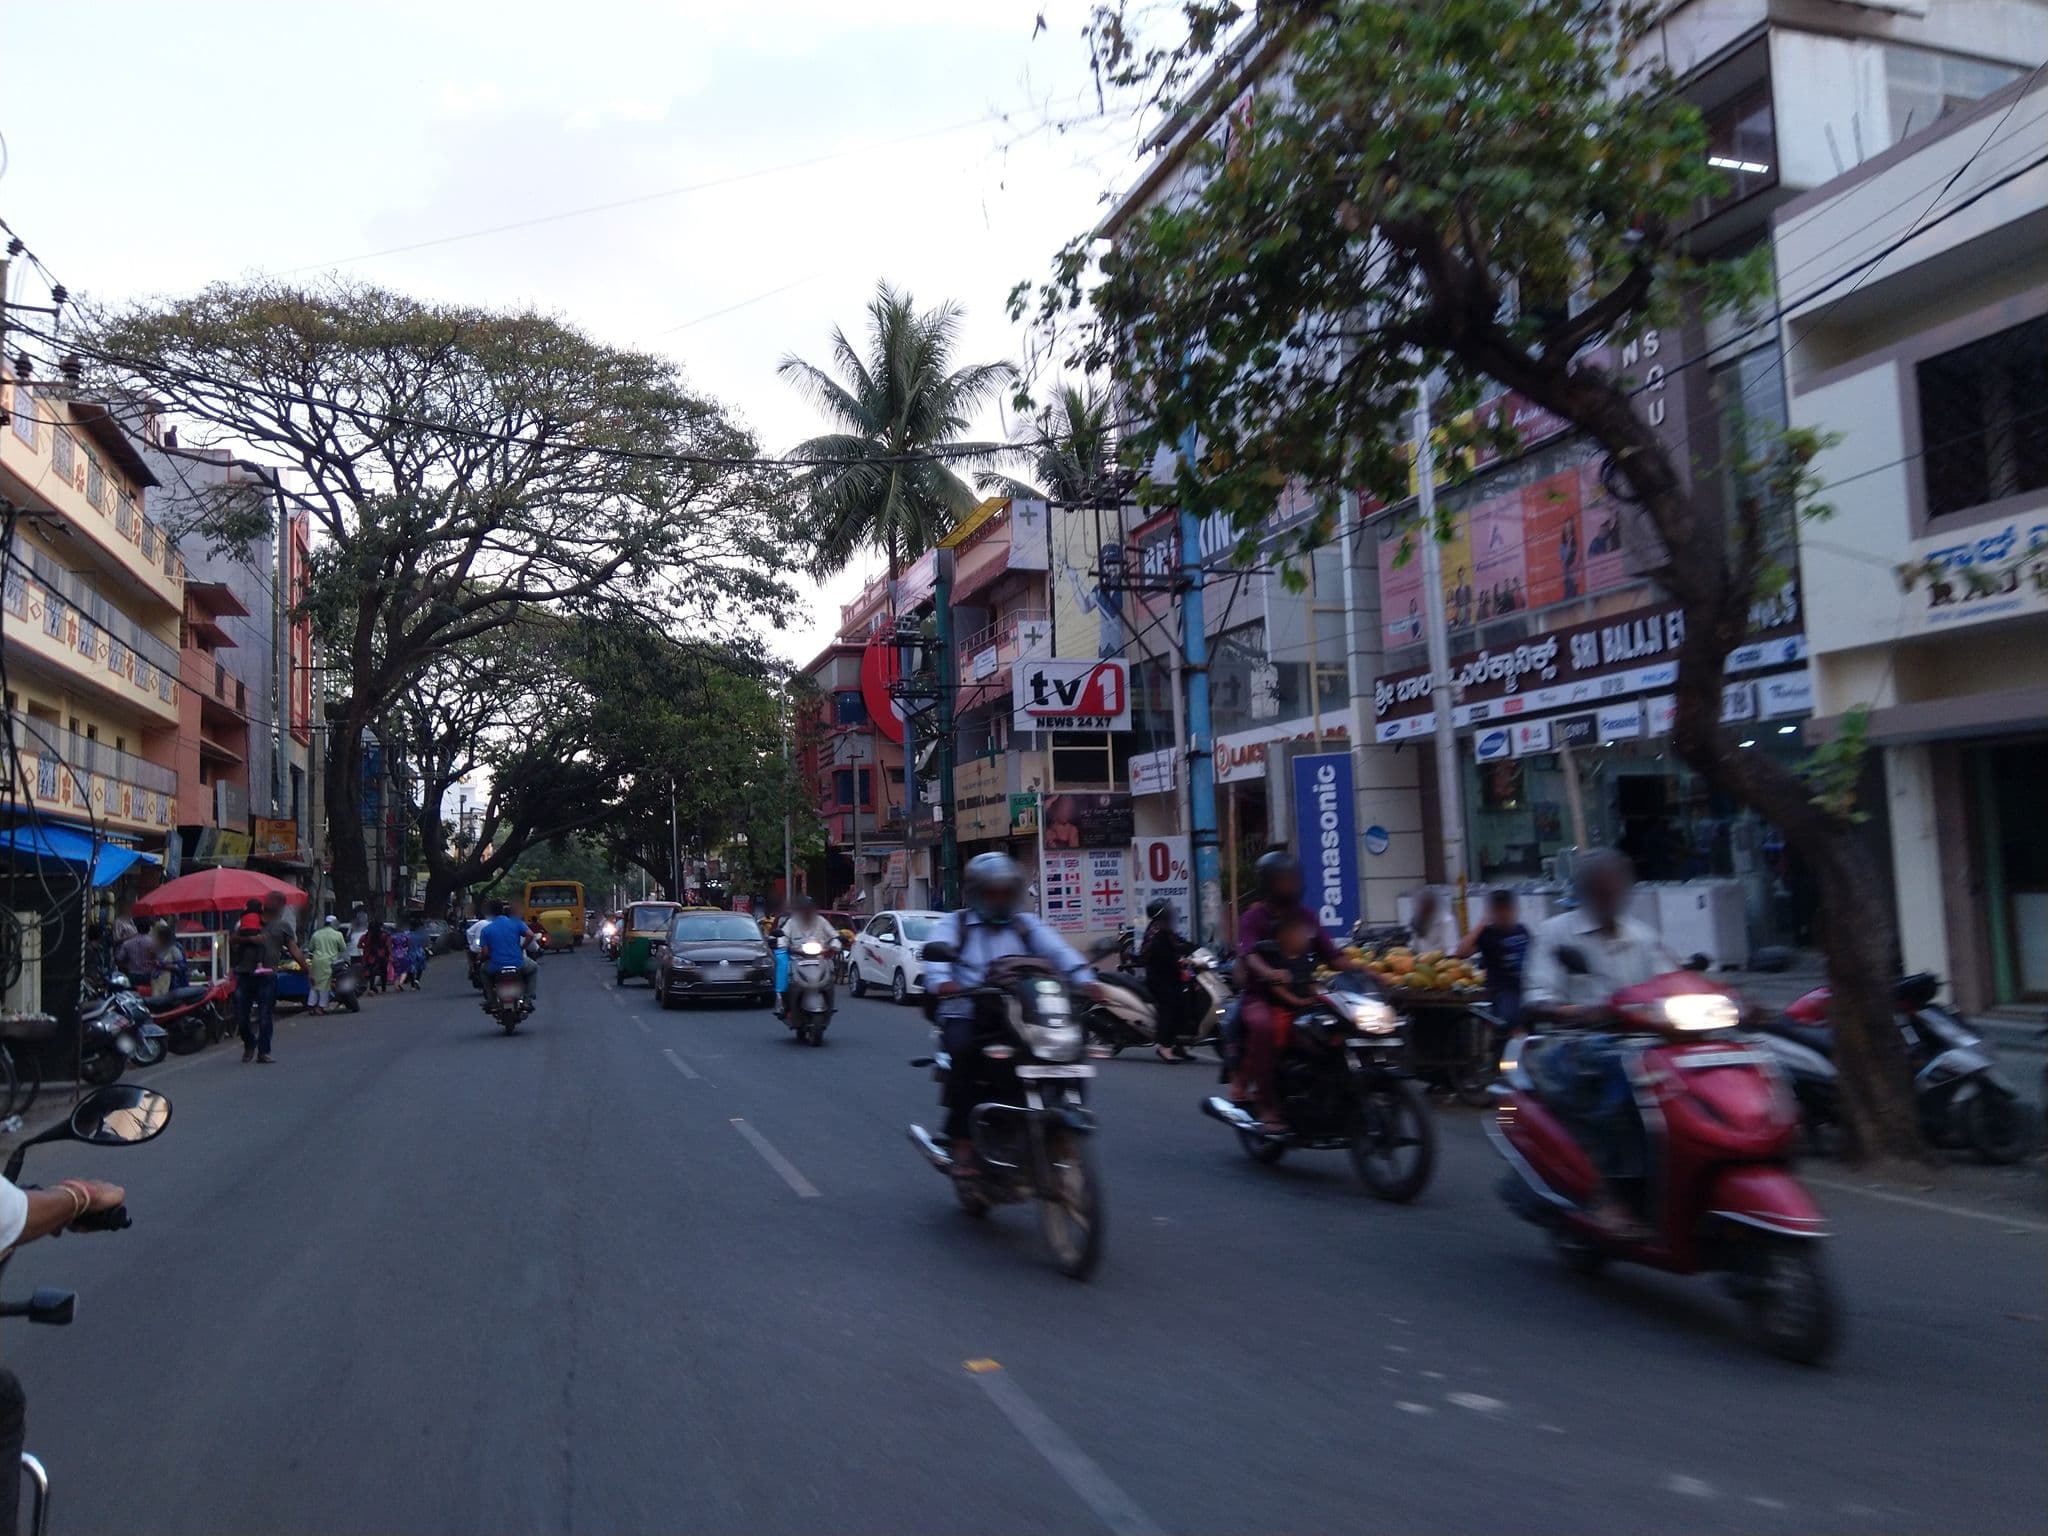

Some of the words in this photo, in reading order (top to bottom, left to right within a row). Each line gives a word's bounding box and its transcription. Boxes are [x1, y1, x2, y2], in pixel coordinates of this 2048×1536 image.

[1570, 630, 1600, 671] SRI
[1036, 716, 1074, 728] NEWS
[1077, 717, 1093, 727] 24
[1095, 717, 1112, 727] X7
[1149, 842, 1188, 882] 0%
[1313, 764, 1344, 927] Panasonic
